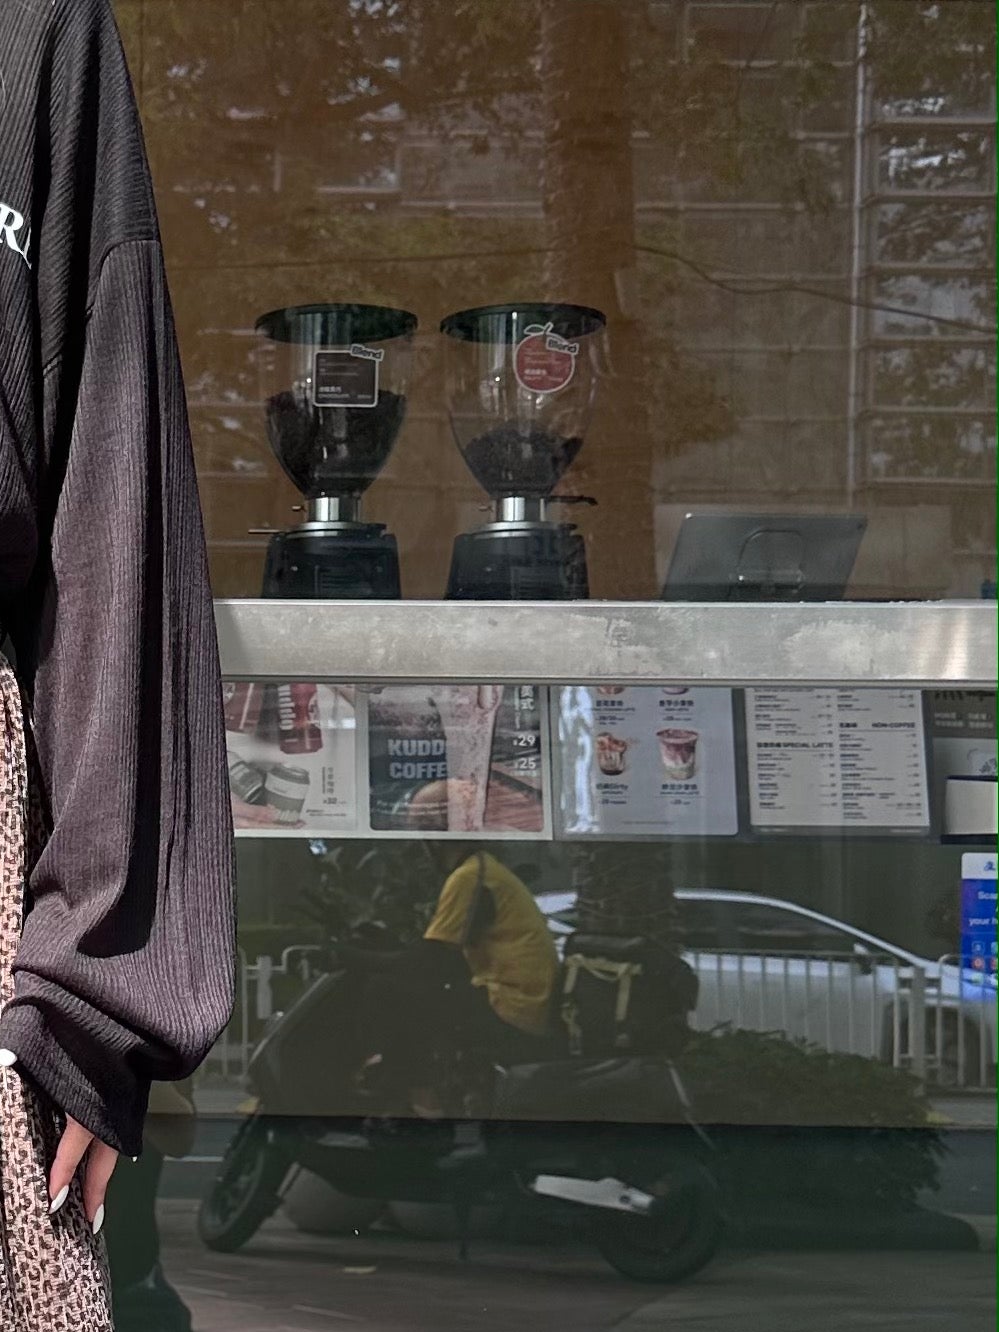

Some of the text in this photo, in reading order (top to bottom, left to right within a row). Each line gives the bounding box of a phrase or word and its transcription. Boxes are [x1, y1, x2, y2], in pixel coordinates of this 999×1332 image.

[548, 339, 577, 352] Blend
[352, 346, 382, 359] Blend
[388, 739, 445, 756] KUDD
[968, 918, 990, 927] your
